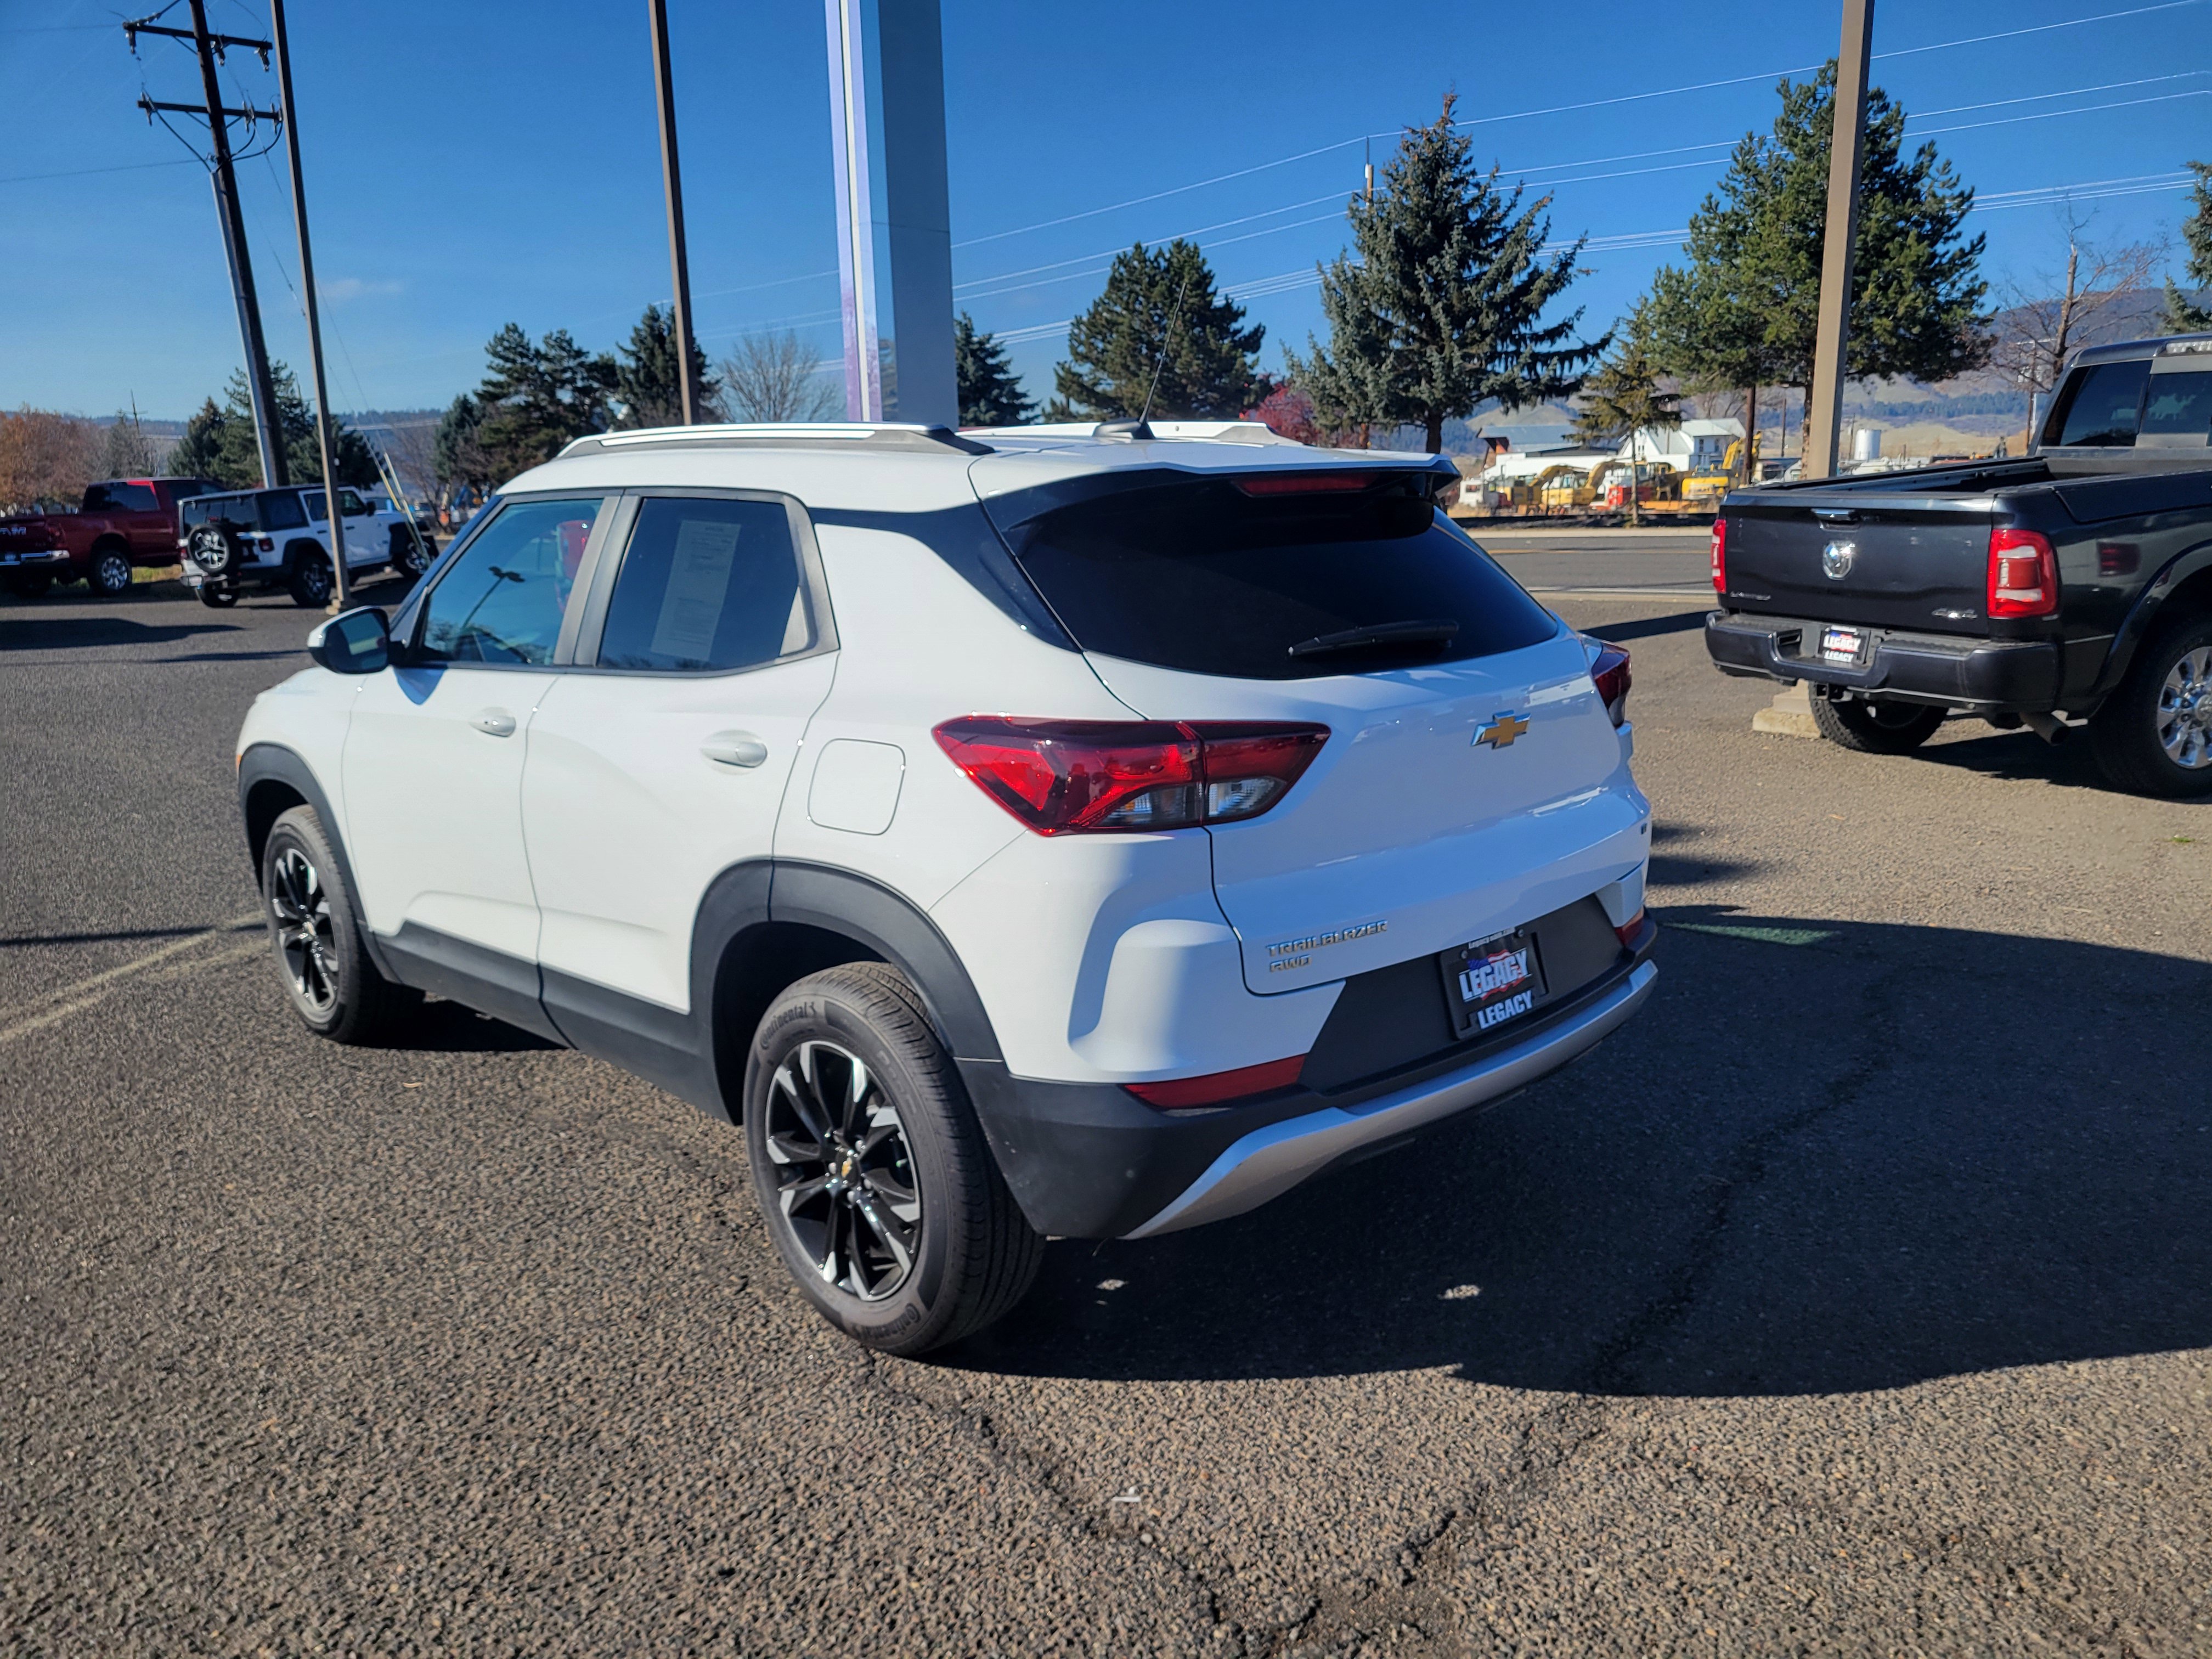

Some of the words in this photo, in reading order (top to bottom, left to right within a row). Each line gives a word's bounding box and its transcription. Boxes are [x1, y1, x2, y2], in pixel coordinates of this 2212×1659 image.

[0, 527, 26, 536] AM
[1823, 634, 1861, 652] LEGACY
[1266, 920, 1388, 956] TRAILBLAZER
[1269, 955, 1312, 972] AWD
[1458, 950, 1528, 1002] LEGACY
[1477, 990, 1533, 1029] LEGACY
